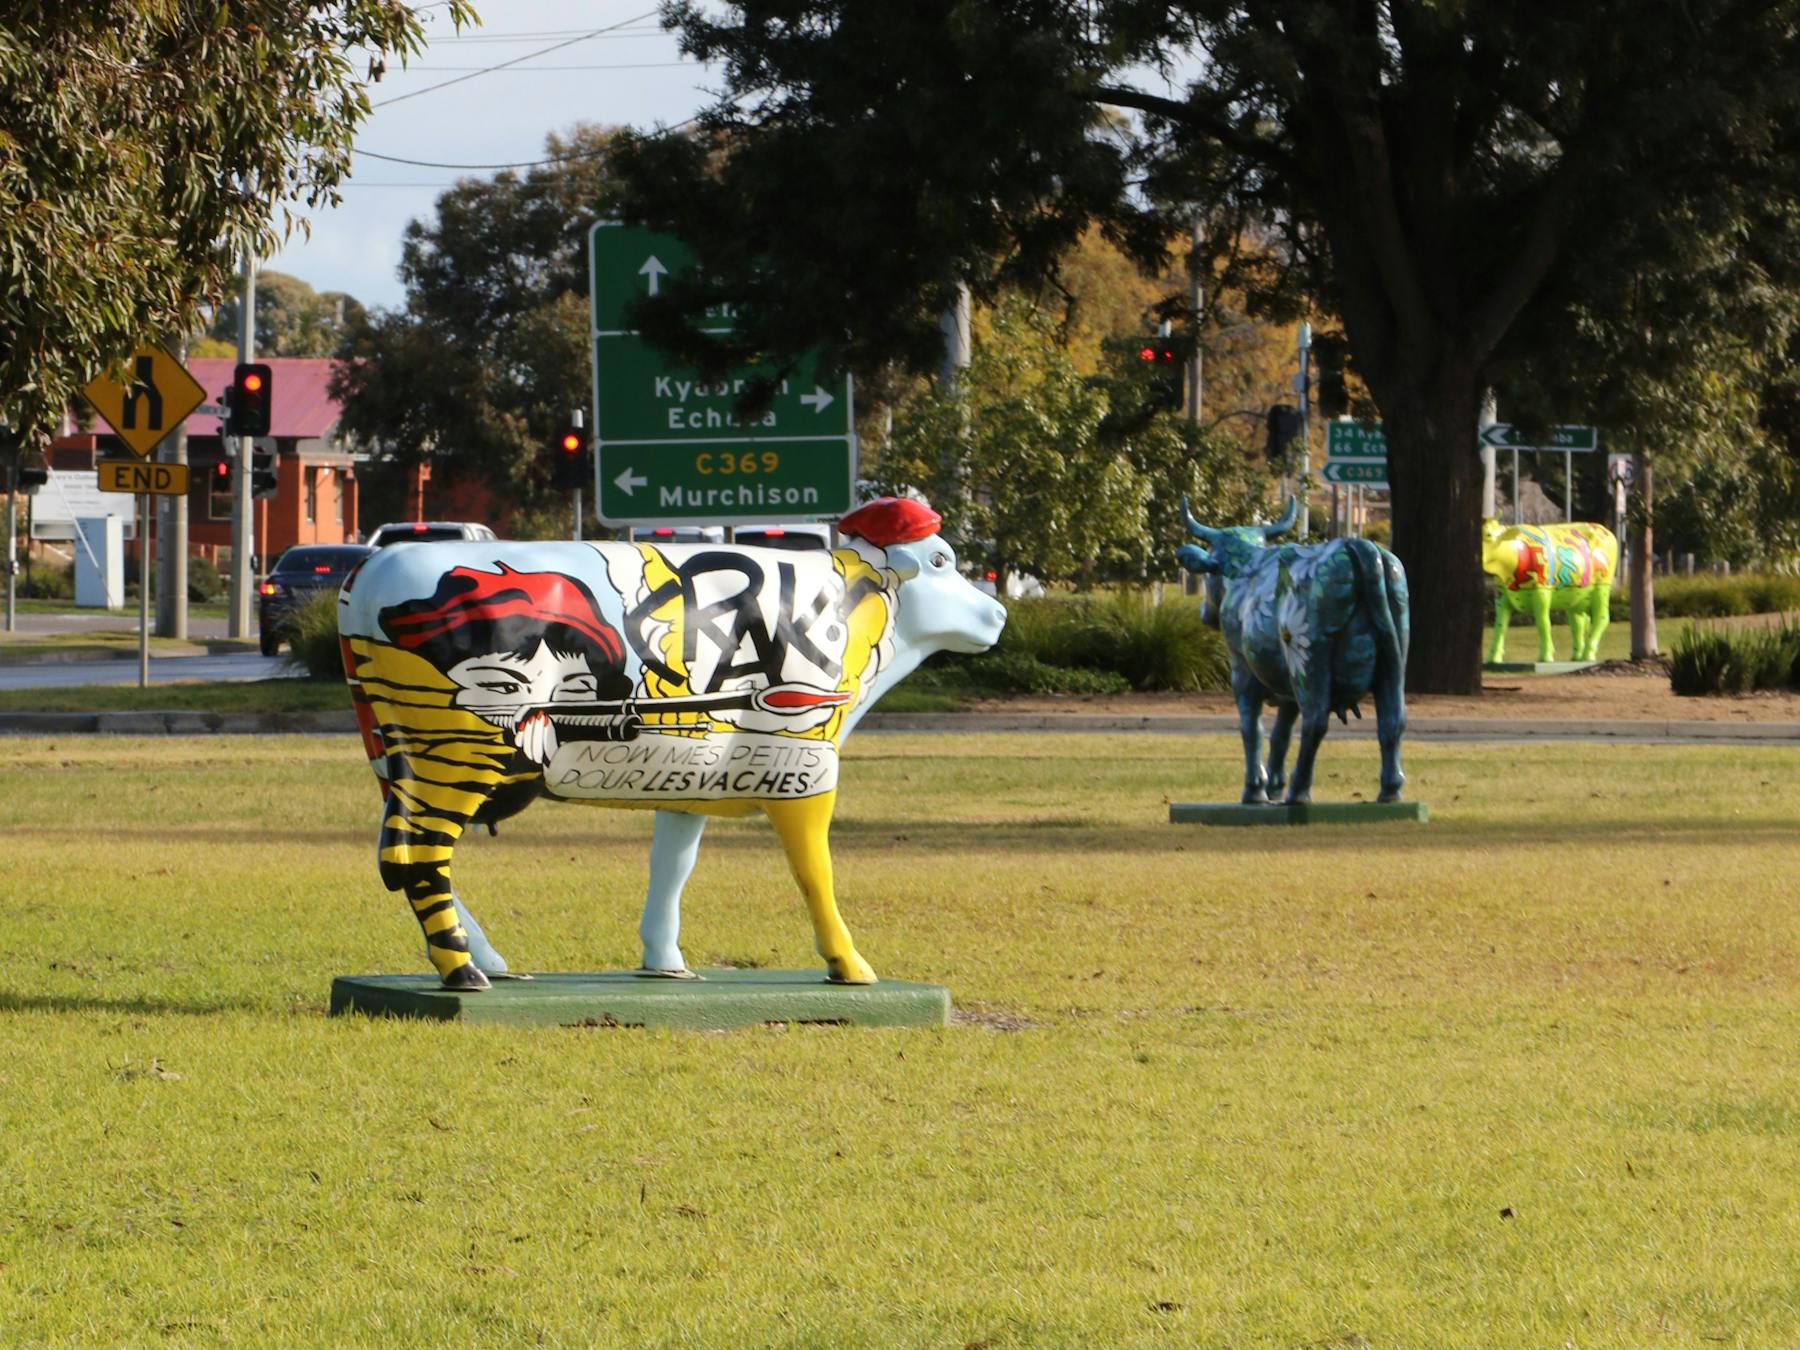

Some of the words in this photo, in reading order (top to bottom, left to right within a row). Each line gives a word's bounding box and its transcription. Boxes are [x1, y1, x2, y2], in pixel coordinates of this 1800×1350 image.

[1334, 428, 1353, 439] 34
[1334, 443, 1352, 453] 66
[695, 451, 780, 475] C369
[1346, 466, 1383, 478] C369
[114, 466, 172, 489] END
[660, 484, 819, 507] Murchison
[576, 745, 660, 765] NOW
[662, 745, 724, 766] MES
[726, 745, 834, 768] PETITS
[556, 769, 645, 790] POUR
[641, 770, 697, 792] LES
